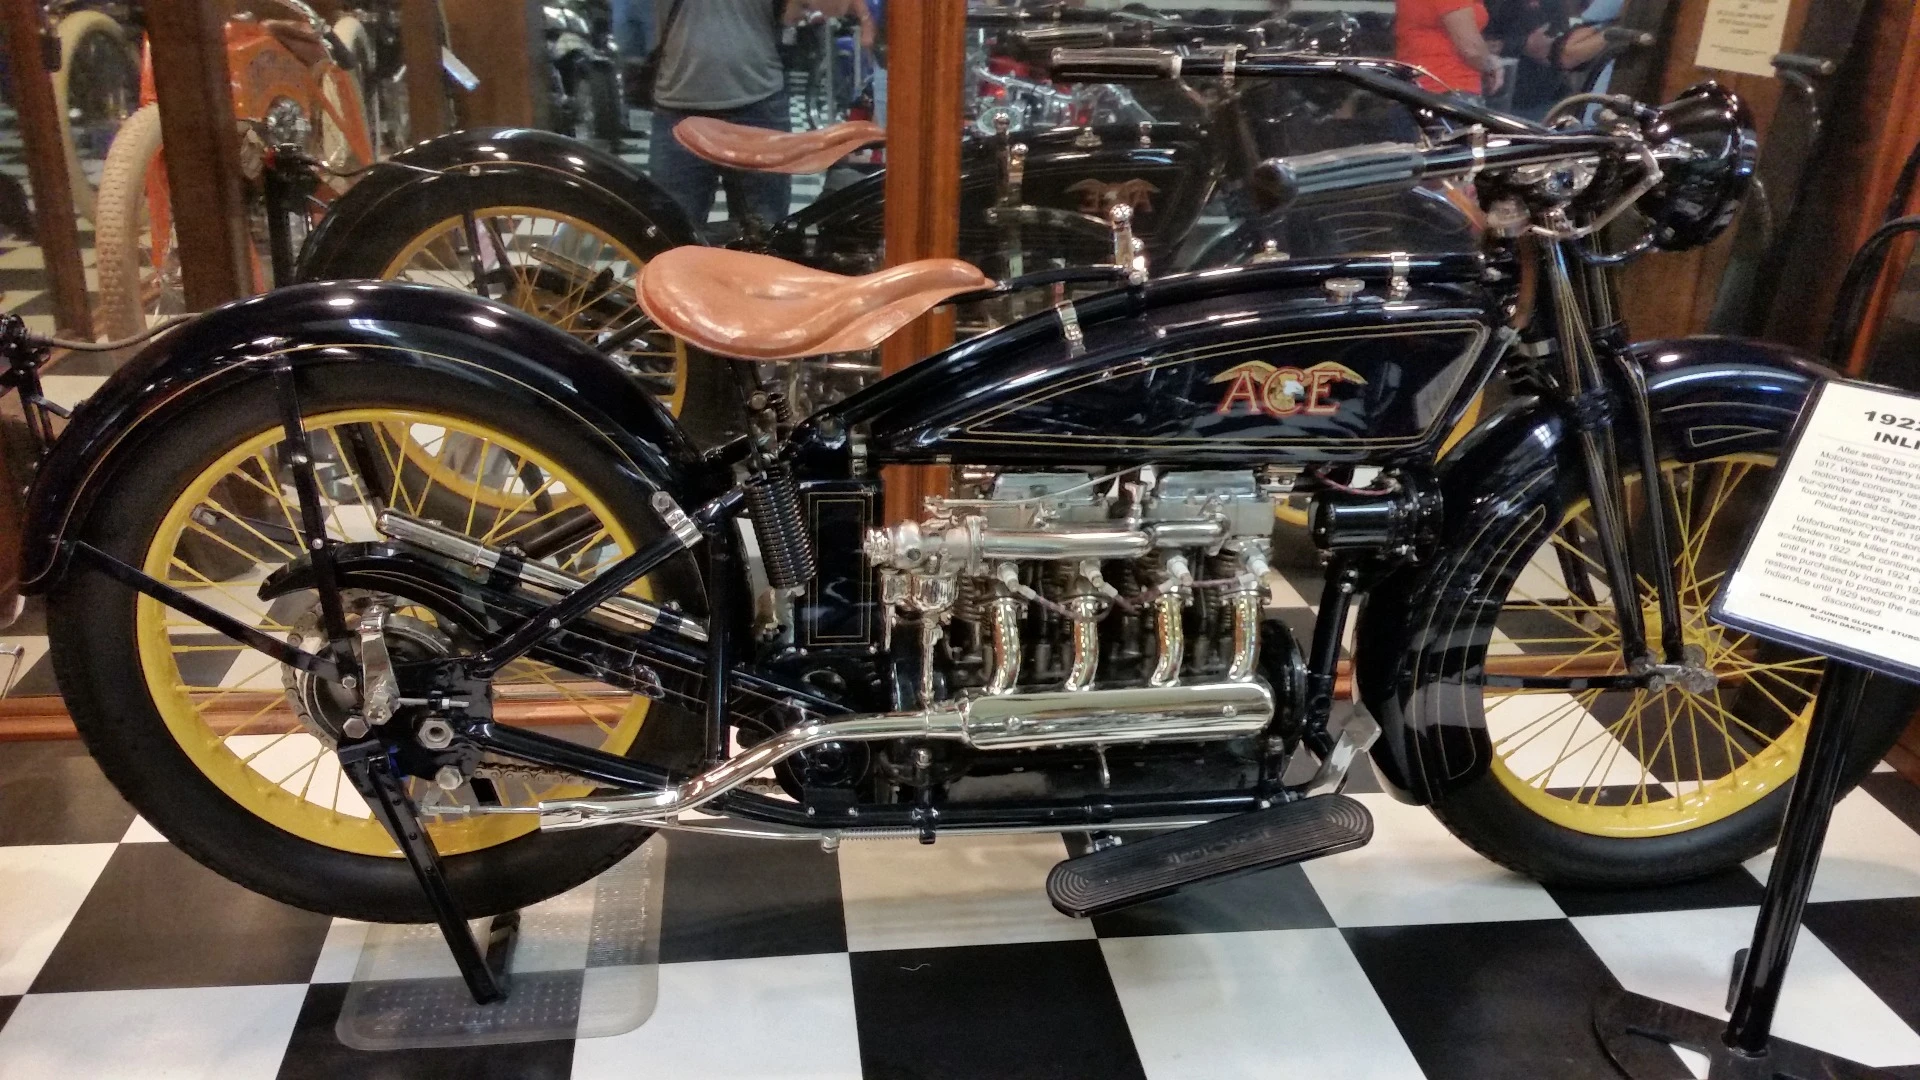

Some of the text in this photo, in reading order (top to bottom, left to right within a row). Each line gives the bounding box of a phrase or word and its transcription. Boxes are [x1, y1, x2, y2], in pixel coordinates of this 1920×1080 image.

[1217, 366, 1342, 417] ACE
[1820, 450, 1869, 468] Motorcycle
[1871, 463, 1912, 480] company
[1837, 446, 1859, 456] After
[1861, 452, 1890, 465] selling
[1892, 457, 1906, 467] his
[1840, 466, 1872, 478] William
[1798, 475, 1853, 494] four-cylinder
[1900, 499, 1918, 510] The
[1811, 469, 1860, 485] motorcycle
[1862, 482, 1904, 498] company
[1801, 486, 1838, 501] founded
[1849, 499, 1862, 507] an
[1863, 502, 1879, 511] old
[1880, 505, 1917, 520] Savage
[1814, 499, 1869, 518] Philadelphia
[1871, 514, 1890, 524] and
[1796, 514, 1856, 536] Unfortunately
[1858, 529, 1871, 539] for
[1872, 534, 1888, 544] the
[1839, 516, 1894, 536] motorcycles
[1777, 531, 1815, 546] accident
[1816, 541, 1825, 549] in
[1857, 551, 1876, 562] Ace
[1780, 542, 1800, 552] until
[1808, 550, 1827, 560] was
[1829, 555, 1873, 572] dissolved
[1874, 567, 1884, 575] in
[1792, 524, 1914, 562] Henderson was killed in an
[1764, 558, 1802, 574] restored
[1803, 568, 1818, 578] the
[1820, 572, 1844, 586] fours
[1845, 579, 1855, 588] to
[1856, 584, 1907, 603] production
[1775, 551, 1798, 562] were
[1798, 557, 1847, 576] purchased
[1849, 570, 1861, 580] by
[1862, 573, 1892, 588] Indian
[1894, 582, 1904, 591] in
[1764, 567, 1792, 581] Indian
[1793, 576, 1811, 587] Ace
[1812, 582, 1833, 593] until
[1835, 586, 1859, 600] 1929
[1860, 594, 1886, 608] when
[1887, 602, 1904, 612] the
[1759, 592, 1772, 600] ON
[1773, 596, 1794, 606] LOAN
[1795, 602, 1818, 613] FROM
[1819, 608, 1850, 622] JUNIOR
[1851, 617, 1884, 632] GLOVER
[1810, 613, 1872, 635] SOUTH DAKOTA
